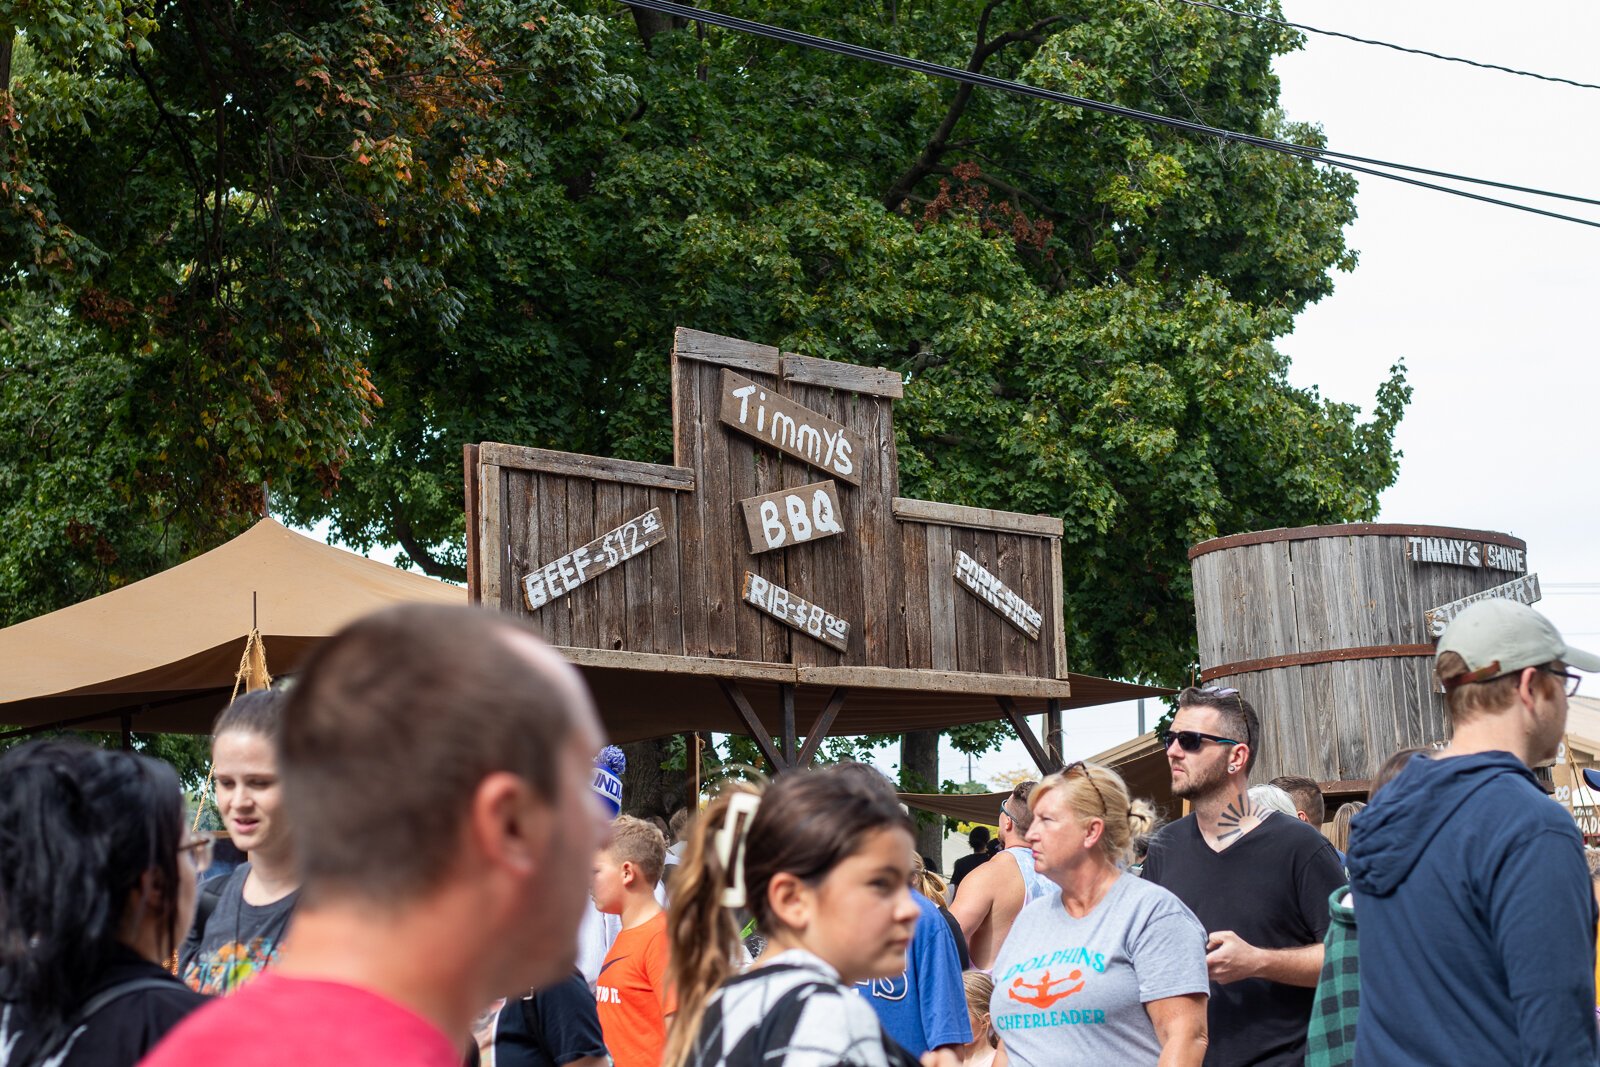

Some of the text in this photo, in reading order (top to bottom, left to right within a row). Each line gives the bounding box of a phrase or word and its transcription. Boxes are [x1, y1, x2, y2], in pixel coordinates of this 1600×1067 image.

[760, 489, 843, 549] BBQ
[1487, 545, 1526, 572] SHINE
[1002, 947, 1105, 982] DOLPHINS
[996, 1009, 1106, 1031] CHEERLEADER
